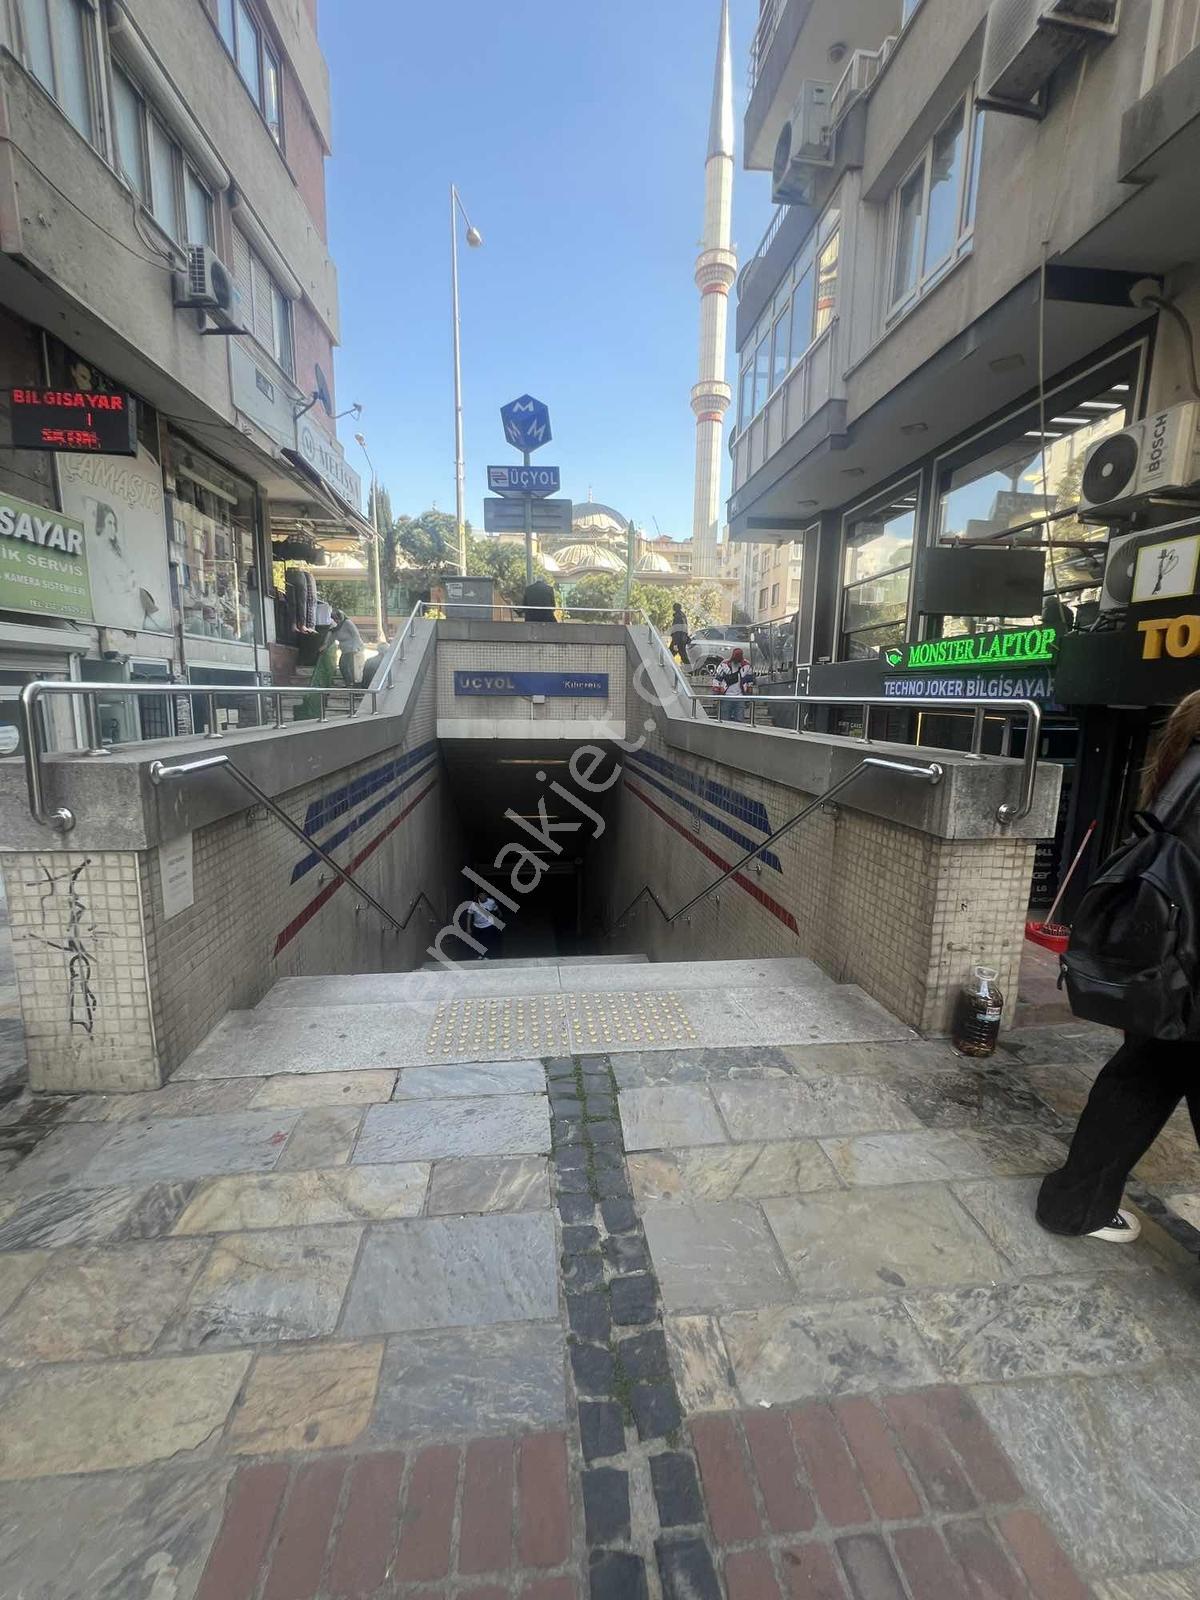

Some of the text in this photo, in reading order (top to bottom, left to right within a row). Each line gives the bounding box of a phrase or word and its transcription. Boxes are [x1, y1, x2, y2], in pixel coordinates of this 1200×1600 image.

[1147, 414, 1168, 472] BOSCH
[510, 468, 557, 488] ÜÇYOL
[908, 628, 1056, 664] MONSTER LAPTOP
[884, 680, 924, 696] TECHNO
[925, 680, 963, 697] JOKER
